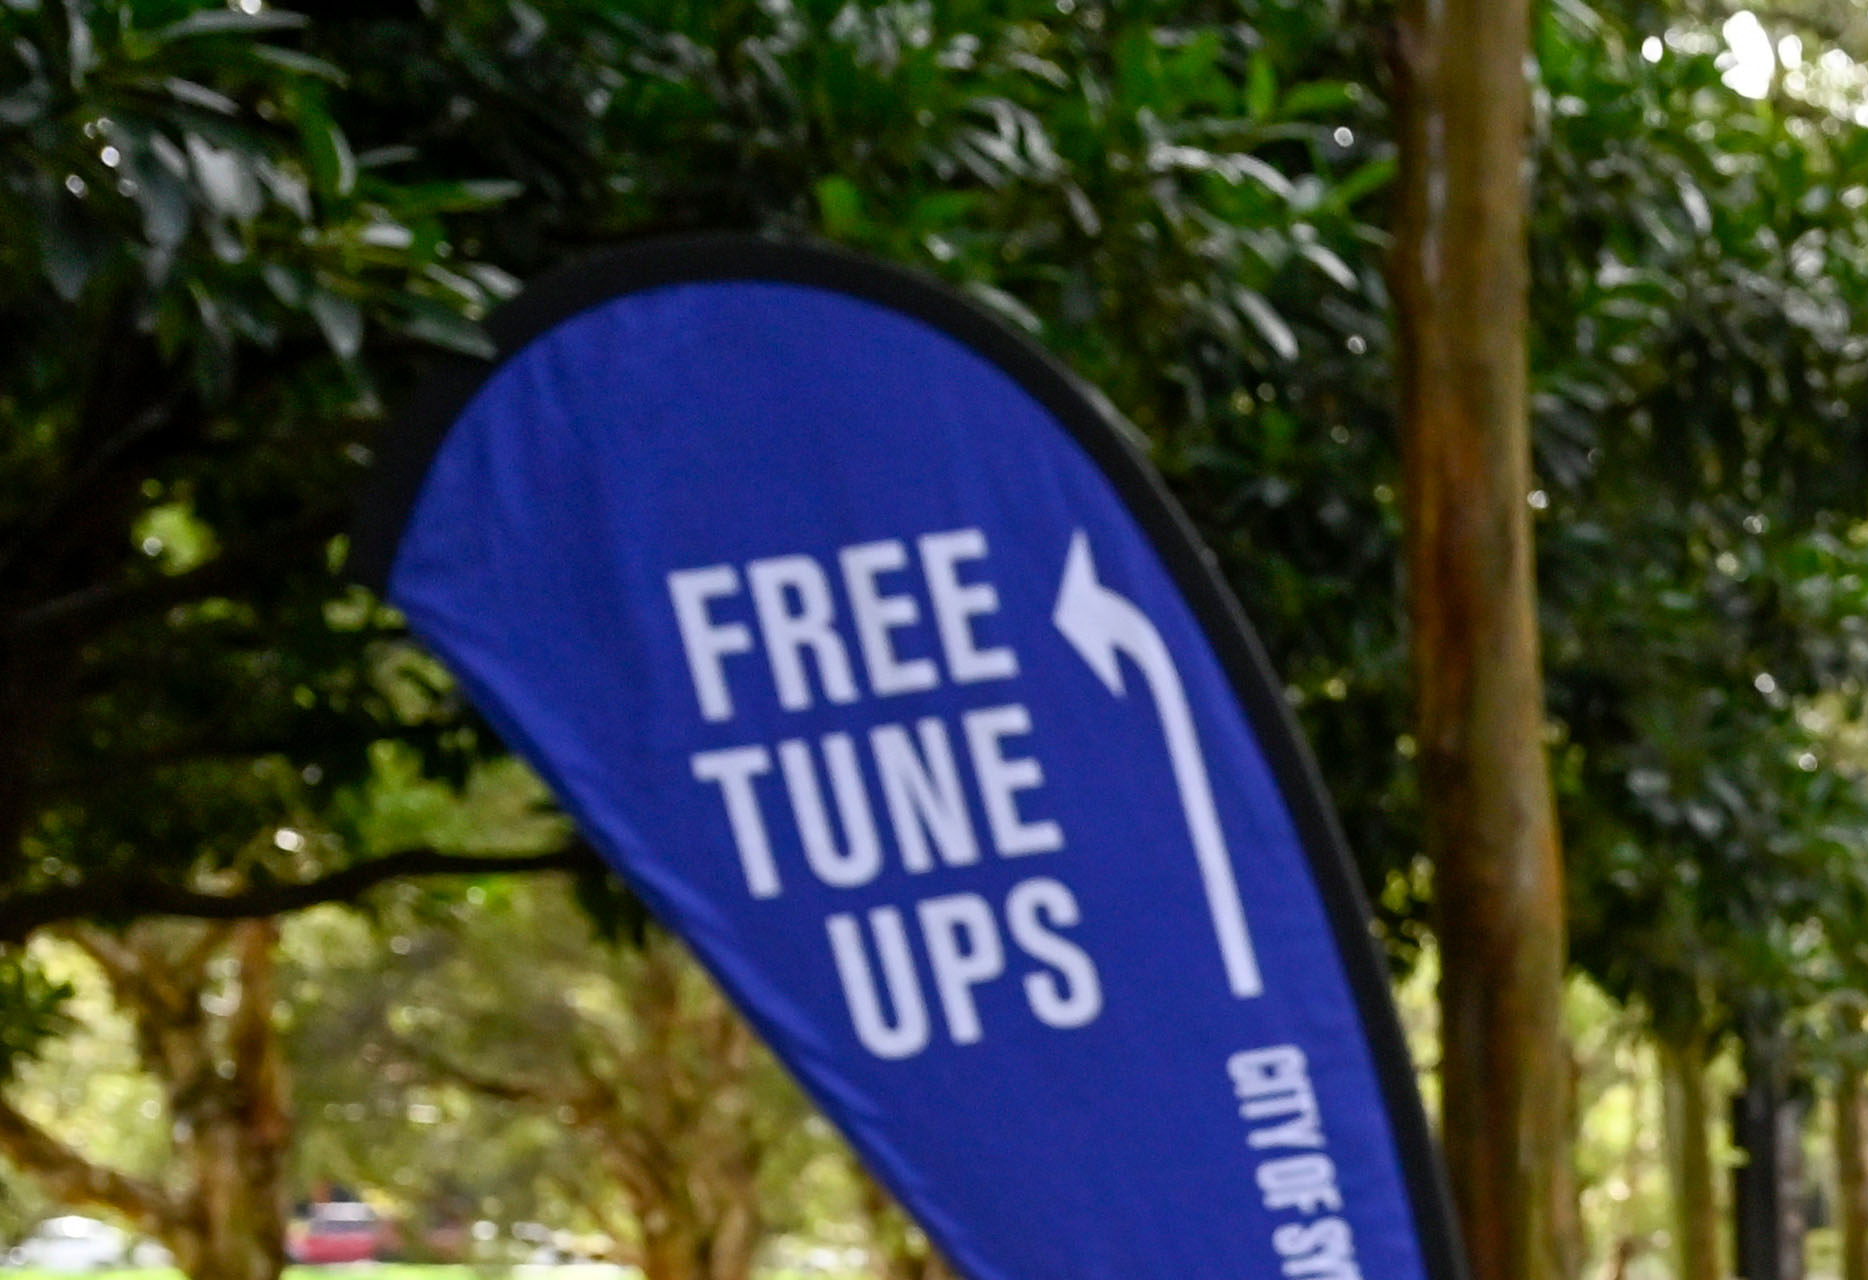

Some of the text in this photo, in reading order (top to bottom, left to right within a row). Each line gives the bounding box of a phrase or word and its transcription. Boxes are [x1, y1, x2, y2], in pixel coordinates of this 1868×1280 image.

[667, 528, 1020, 722] FREE
[691, 703, 1065, 900] TUNE
[825, 877, 1102, 1060] UPS
[1226, 1044, 1326, 1150] CITY
[1255, 1153, 1344, 1211] OF
